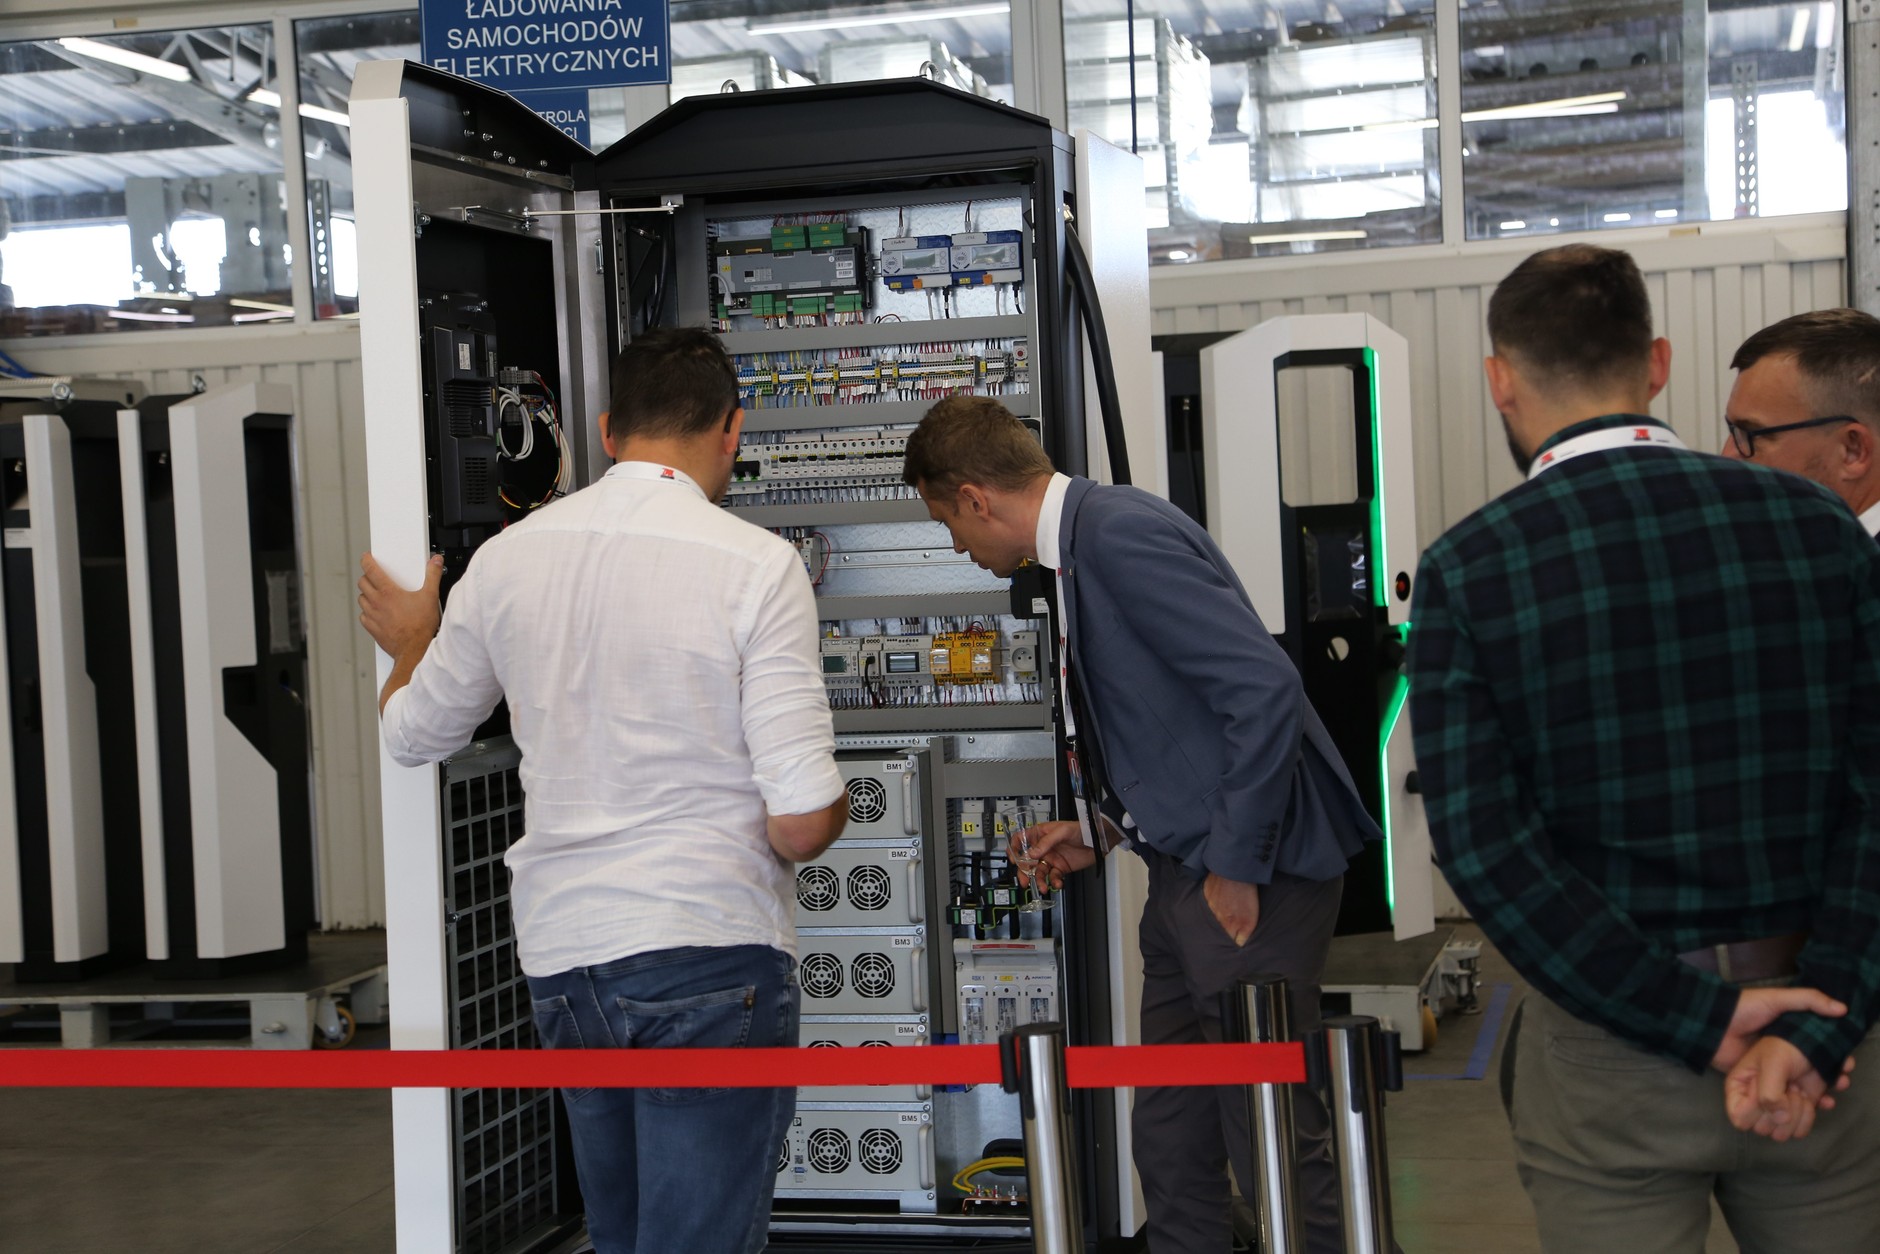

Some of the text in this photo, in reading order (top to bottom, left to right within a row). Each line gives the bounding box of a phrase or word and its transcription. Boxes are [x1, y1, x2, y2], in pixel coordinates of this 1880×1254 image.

[447, 14, 643, 50] SAMOCHODÓW
[433, 46, 659, 78] ELEKTRYCZNYCH
[964, 823, 973, 832] L1
